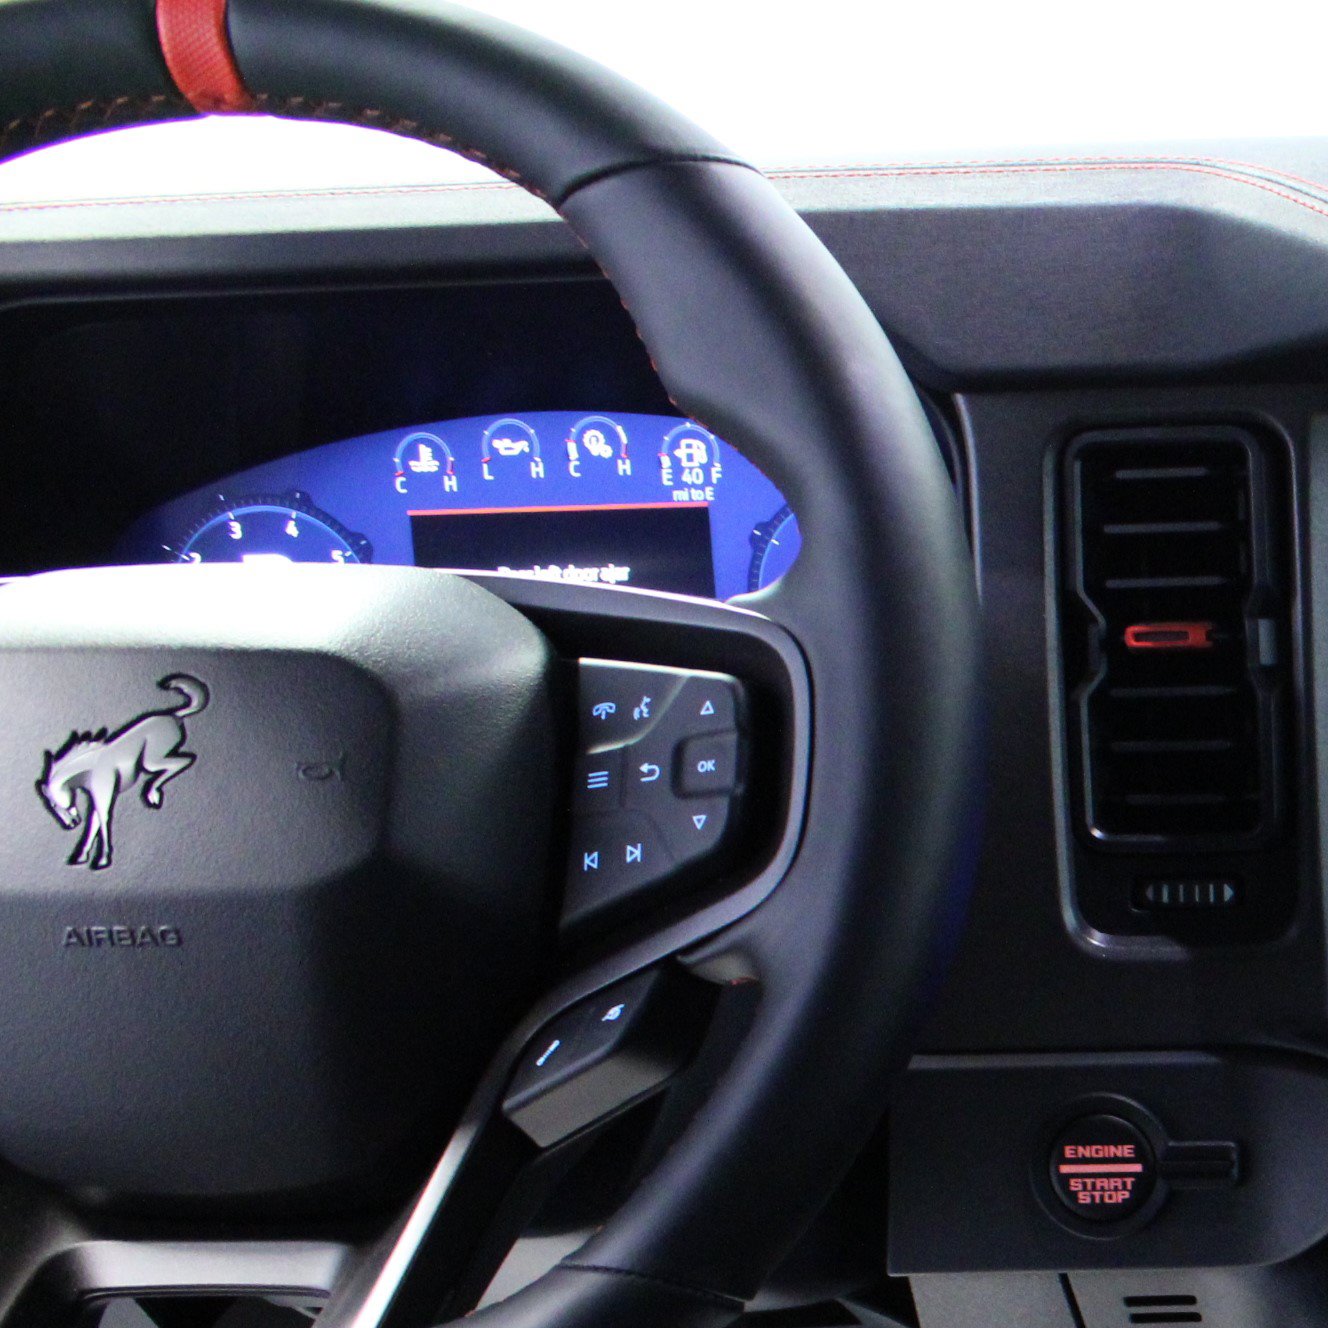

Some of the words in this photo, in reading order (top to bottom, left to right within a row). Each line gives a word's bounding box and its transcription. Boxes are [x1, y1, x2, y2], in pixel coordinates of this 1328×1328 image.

[697, 759, 716, 773] OK
[63, 925, 183, 948] AIRBAG
[1064, 1144, 1136, 1158] ENGINE
[1069, 1177, 1136, 1191] START
[1077, 1190, 1131, 1204] STOP
